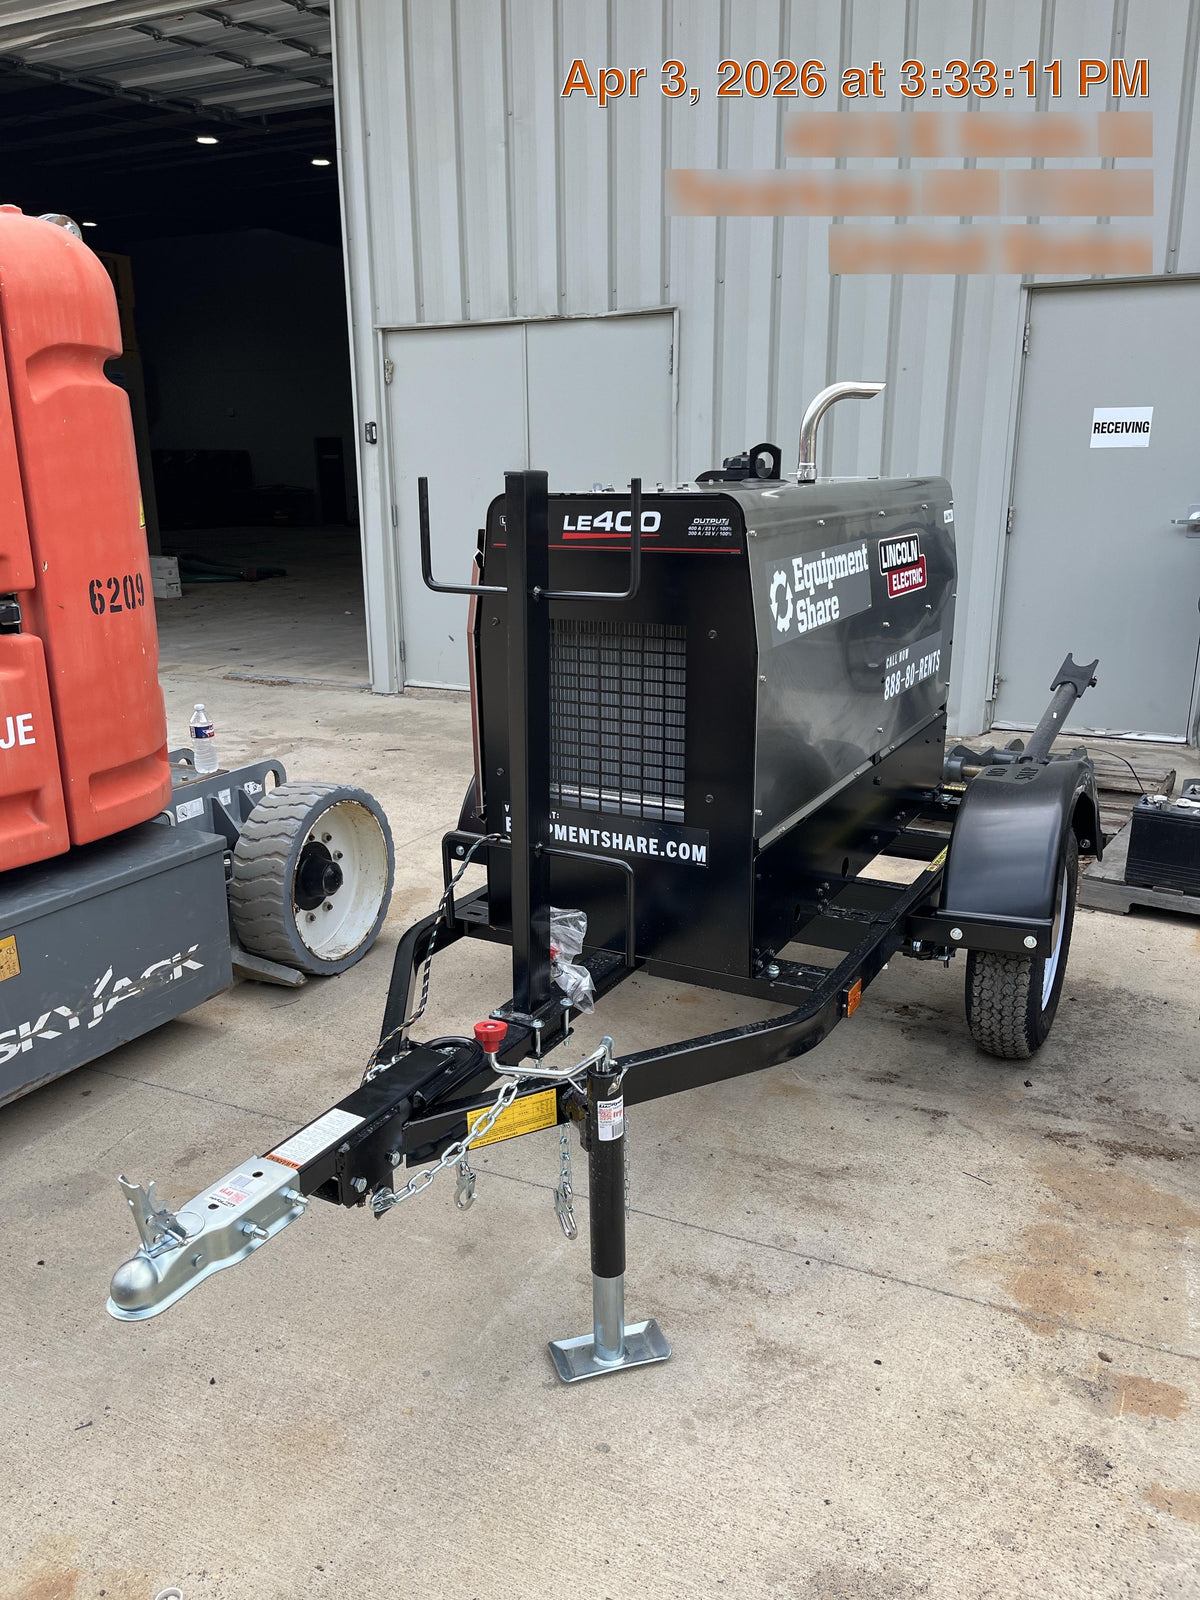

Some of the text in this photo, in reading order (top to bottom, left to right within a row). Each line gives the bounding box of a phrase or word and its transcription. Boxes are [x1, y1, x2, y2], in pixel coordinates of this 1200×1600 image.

[1093, 421, 1150, 434] RECEIVING
[792, 543, 868, 596] Equipment
[881, 540, 918, 569] LINCOLN
[89, 572, 145, 615] 6209
[892, 567, 923, 591] ELECTRIC
[796, 595, 840, 634] Share
[884, 649, 941, 700] 888-80-RENTS
[886, 657, 898, 669] CALL
